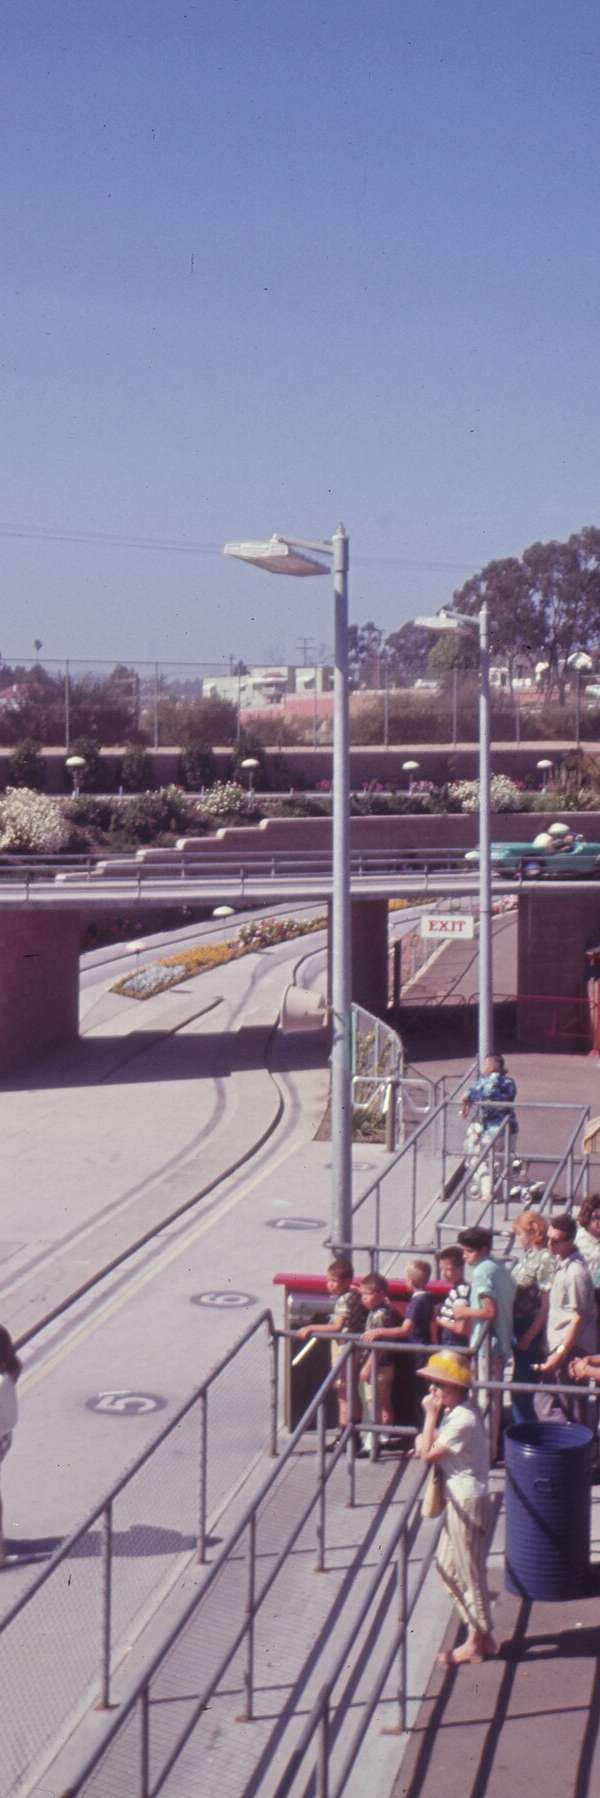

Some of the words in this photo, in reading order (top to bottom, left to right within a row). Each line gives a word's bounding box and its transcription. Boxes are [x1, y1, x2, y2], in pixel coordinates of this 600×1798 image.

[428, 919, 466, 932] EXIT
[200, 1294, 250, 1305] 6
[96, 1393, 157, 1413] 5
